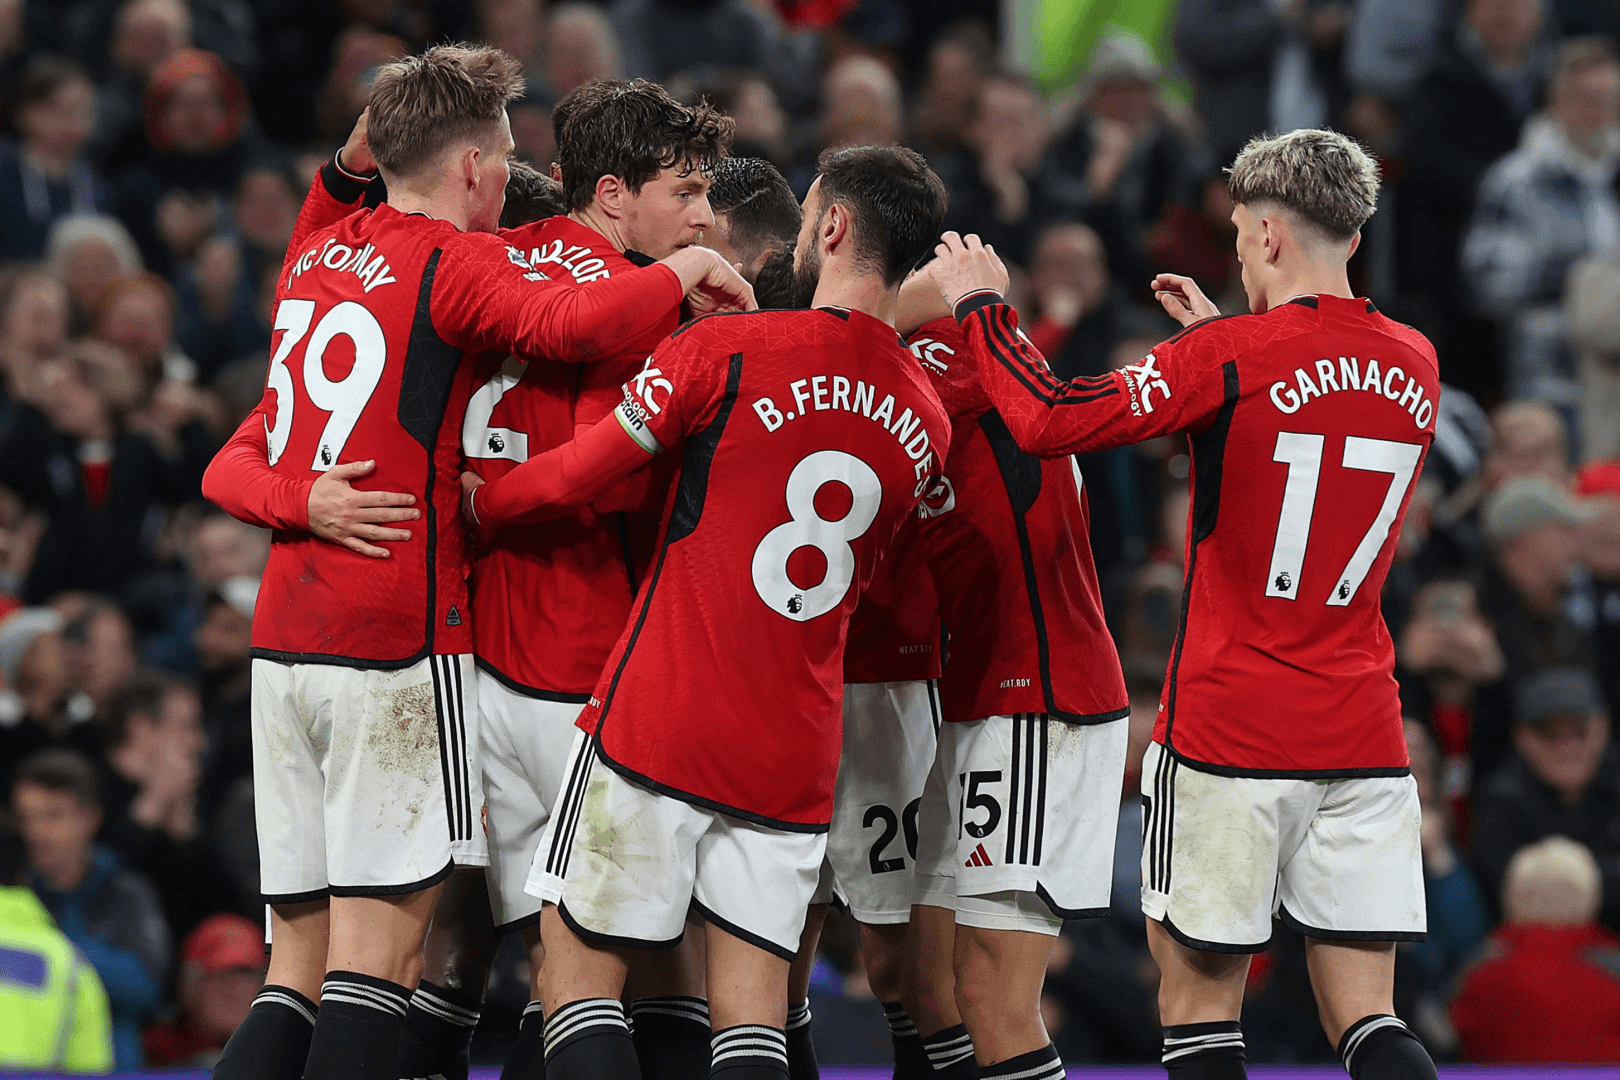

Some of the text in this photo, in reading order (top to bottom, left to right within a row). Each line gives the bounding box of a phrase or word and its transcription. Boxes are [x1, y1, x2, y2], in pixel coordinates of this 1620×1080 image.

[264, 298, 387, 473] 39
[1269, 356, 1433, 430] GARNACHO
[751, 449, 882, 622] 8
[1265, 431, 1424, 607] 17
[958, 770, 1002, 840] 5
